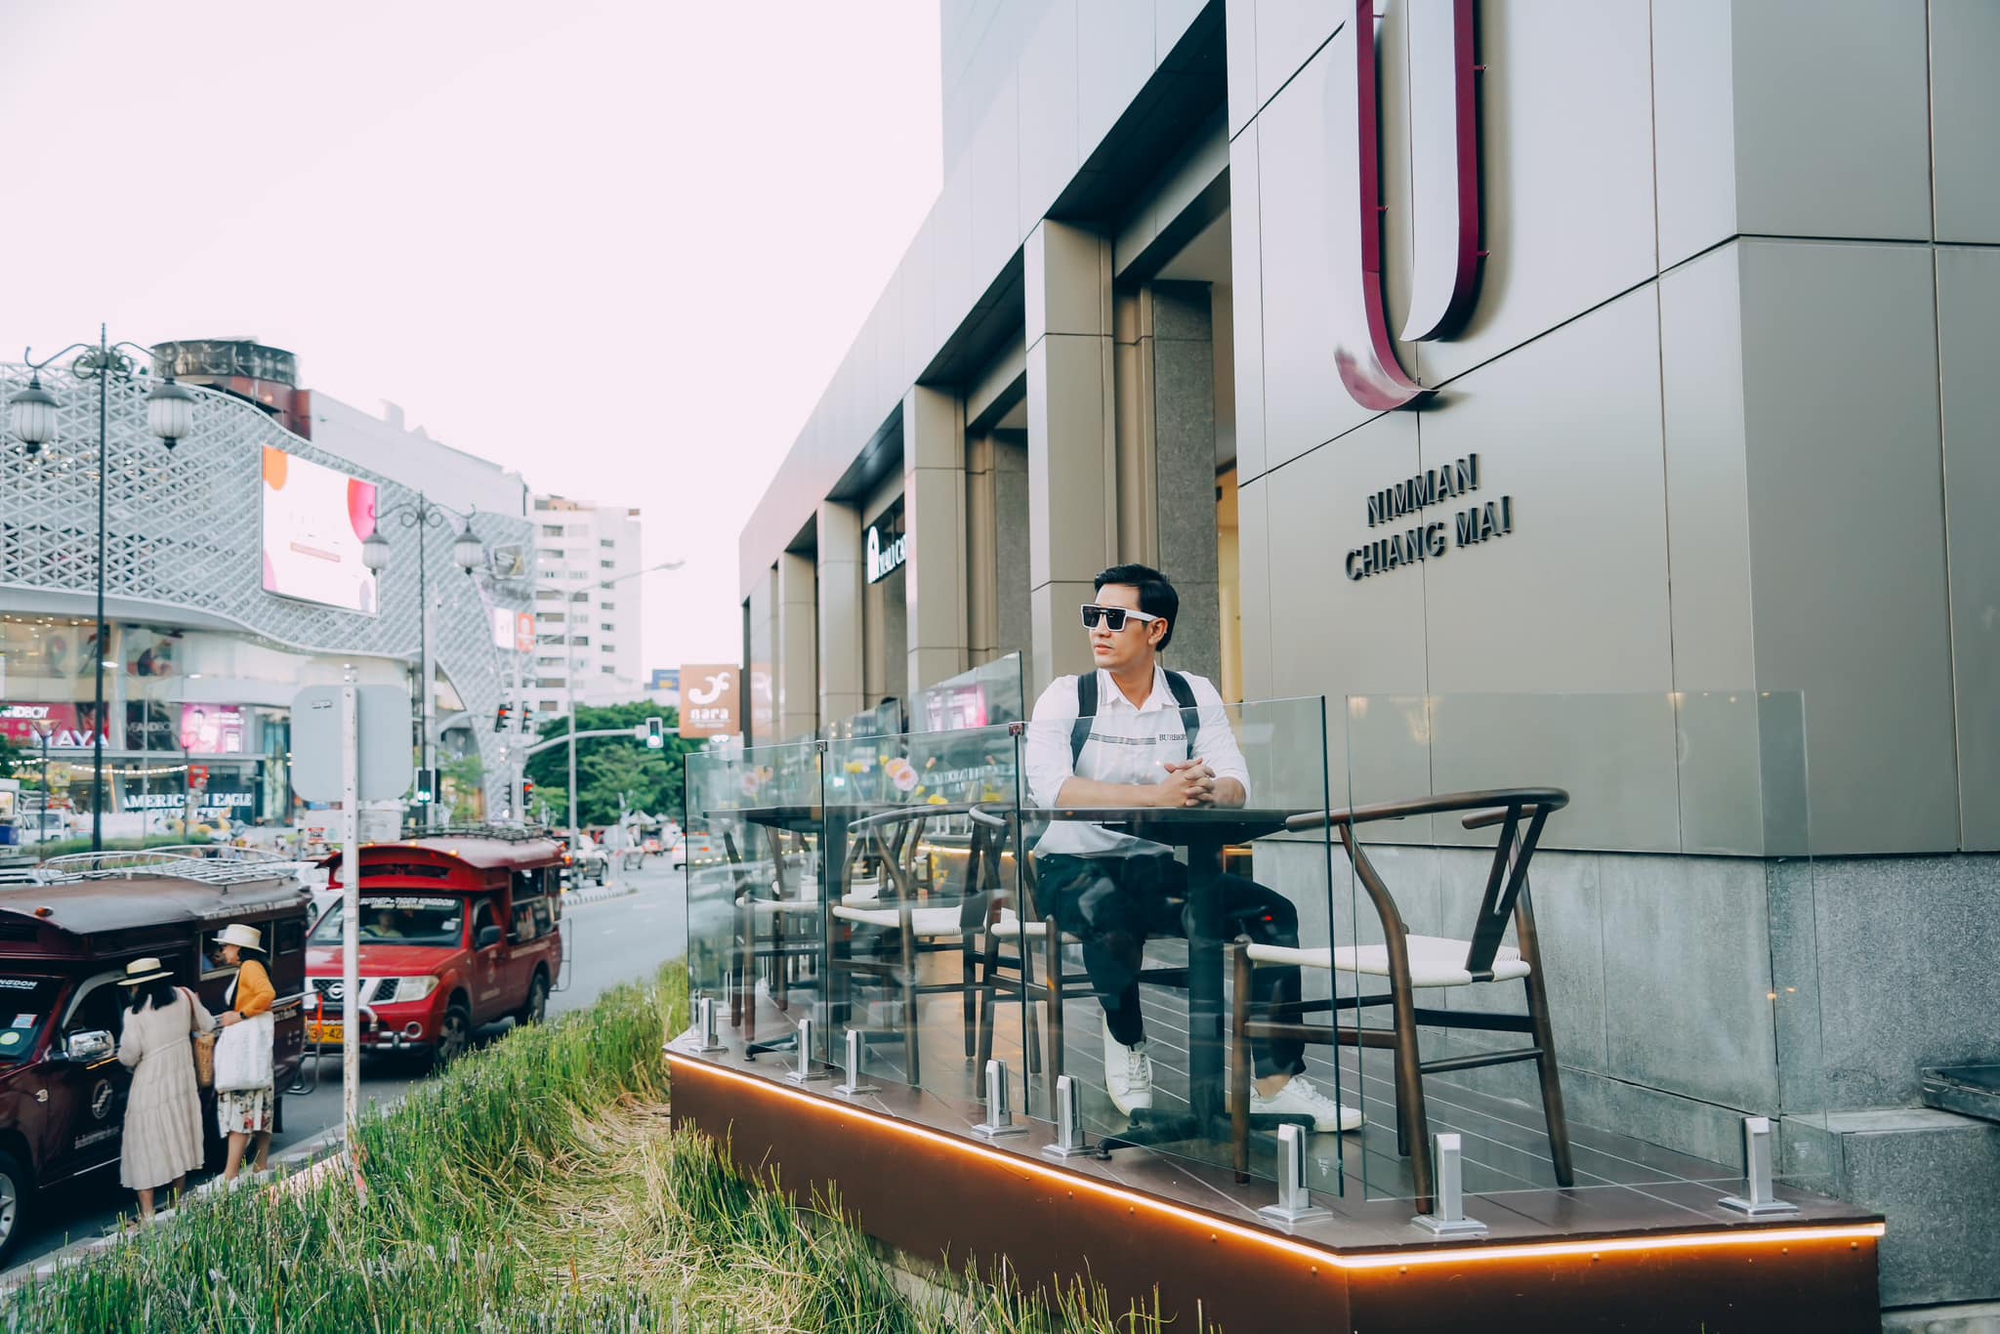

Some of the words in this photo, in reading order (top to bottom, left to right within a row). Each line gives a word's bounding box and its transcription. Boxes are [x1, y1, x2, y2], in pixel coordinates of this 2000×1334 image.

[1367, 453, 1477, 527] NIMMAN
[1345, 522, 1446, 580] CHIANG
[1455, 495, 1512, 548] MAI
[690, 708, 729, 720] nara
[123, 794, 209, 808] AMERIC
[213, 793, 252, 807] EAGLE
